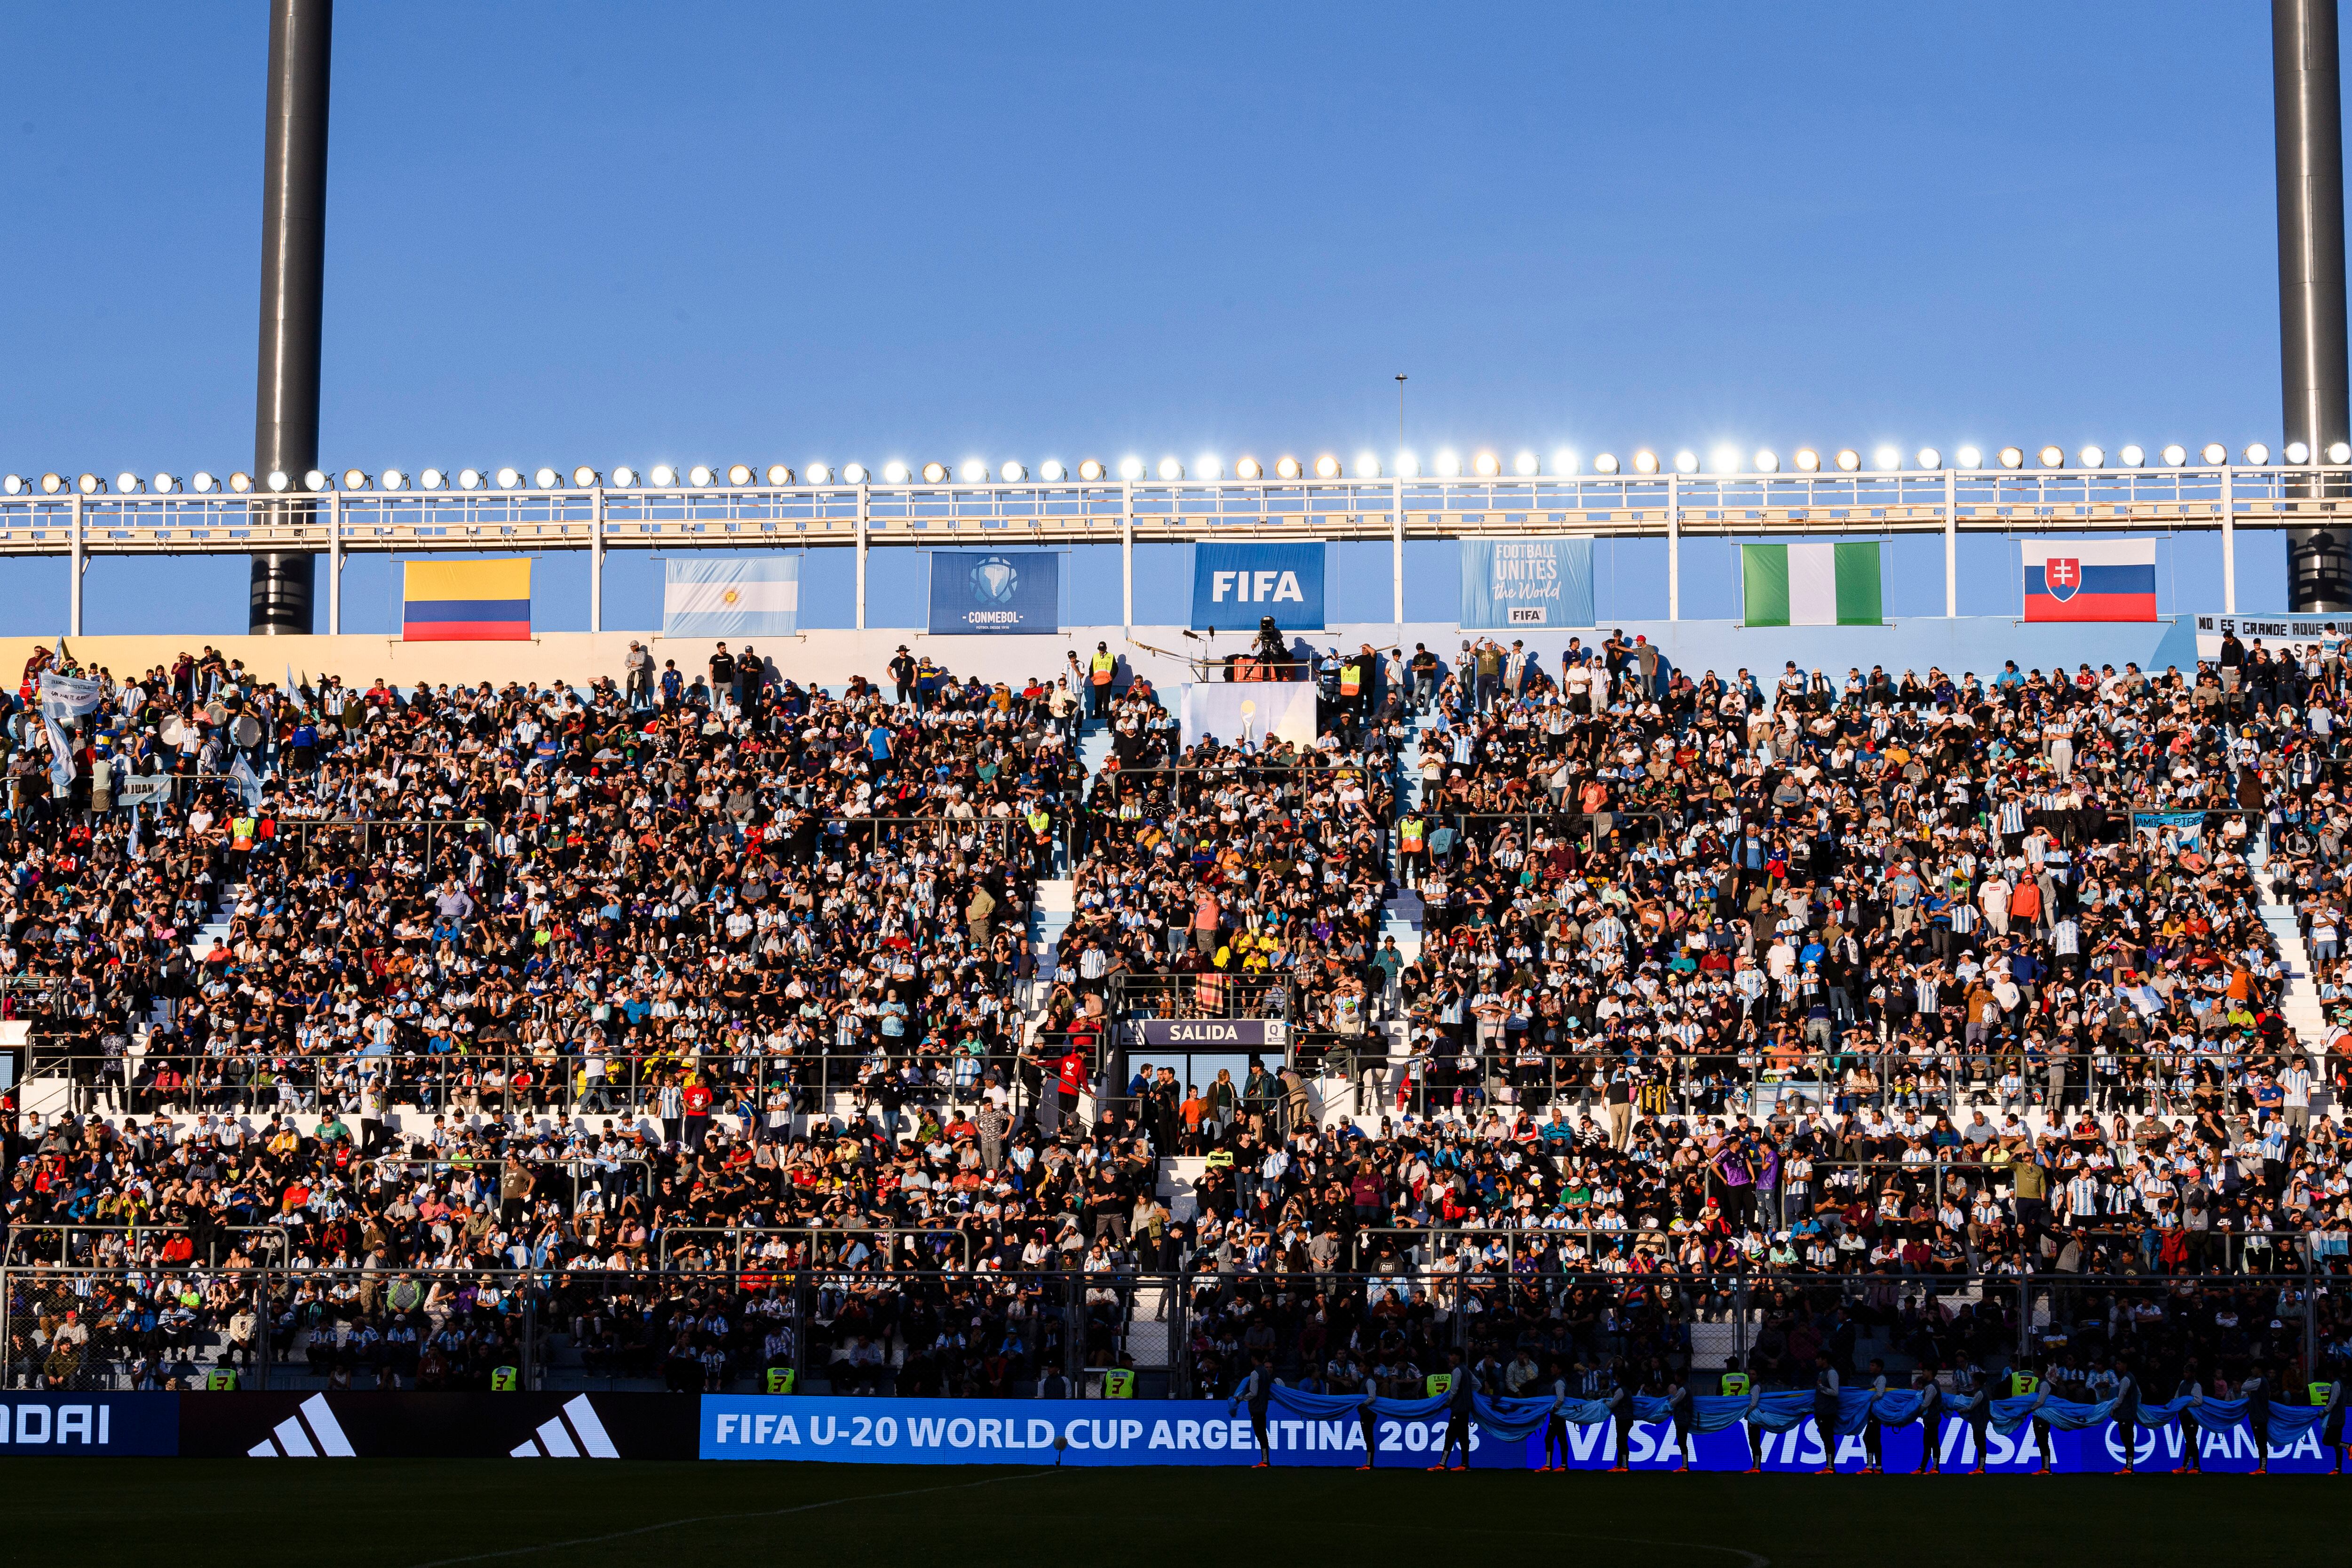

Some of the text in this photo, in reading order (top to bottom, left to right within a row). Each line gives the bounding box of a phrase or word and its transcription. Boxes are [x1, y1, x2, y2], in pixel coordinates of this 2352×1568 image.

[1496, 544, 1557, 559] FOOTBALL
[1496, 559, 1557, 580] UNITES
[1213, 571, 1304, 602] FIFA
[1492, 581, 1562, 600] the World
[1513, 611, 1540, 621] FIFA
[2199, 617, 2213, 630] NO
[2220, 619, 2234, 632] ES
[2242, 622, 2288, 636] GRANDE
[2292, 623, 2328, 636] AQUE
[95, 734, 103, 745] 10
[131, 784, 154, 794] JUAN
[2135, 814, 2205, 828] VAMOS PIBES
[1169, 1025, 1238, 1041] SALIDA
[1269, 1024, 1278, 1036] Q
[0, 1404, 109, 1444] DAI
[717, 1414, 801, 1444] FIFA
[810, 1416, 898, 1447] U-20
[907, 1417, 1055, 1449] WORLD
[1064, 1419, 1143, 1449] CUP
[1565, 1414, 1698, 1462] VISA
